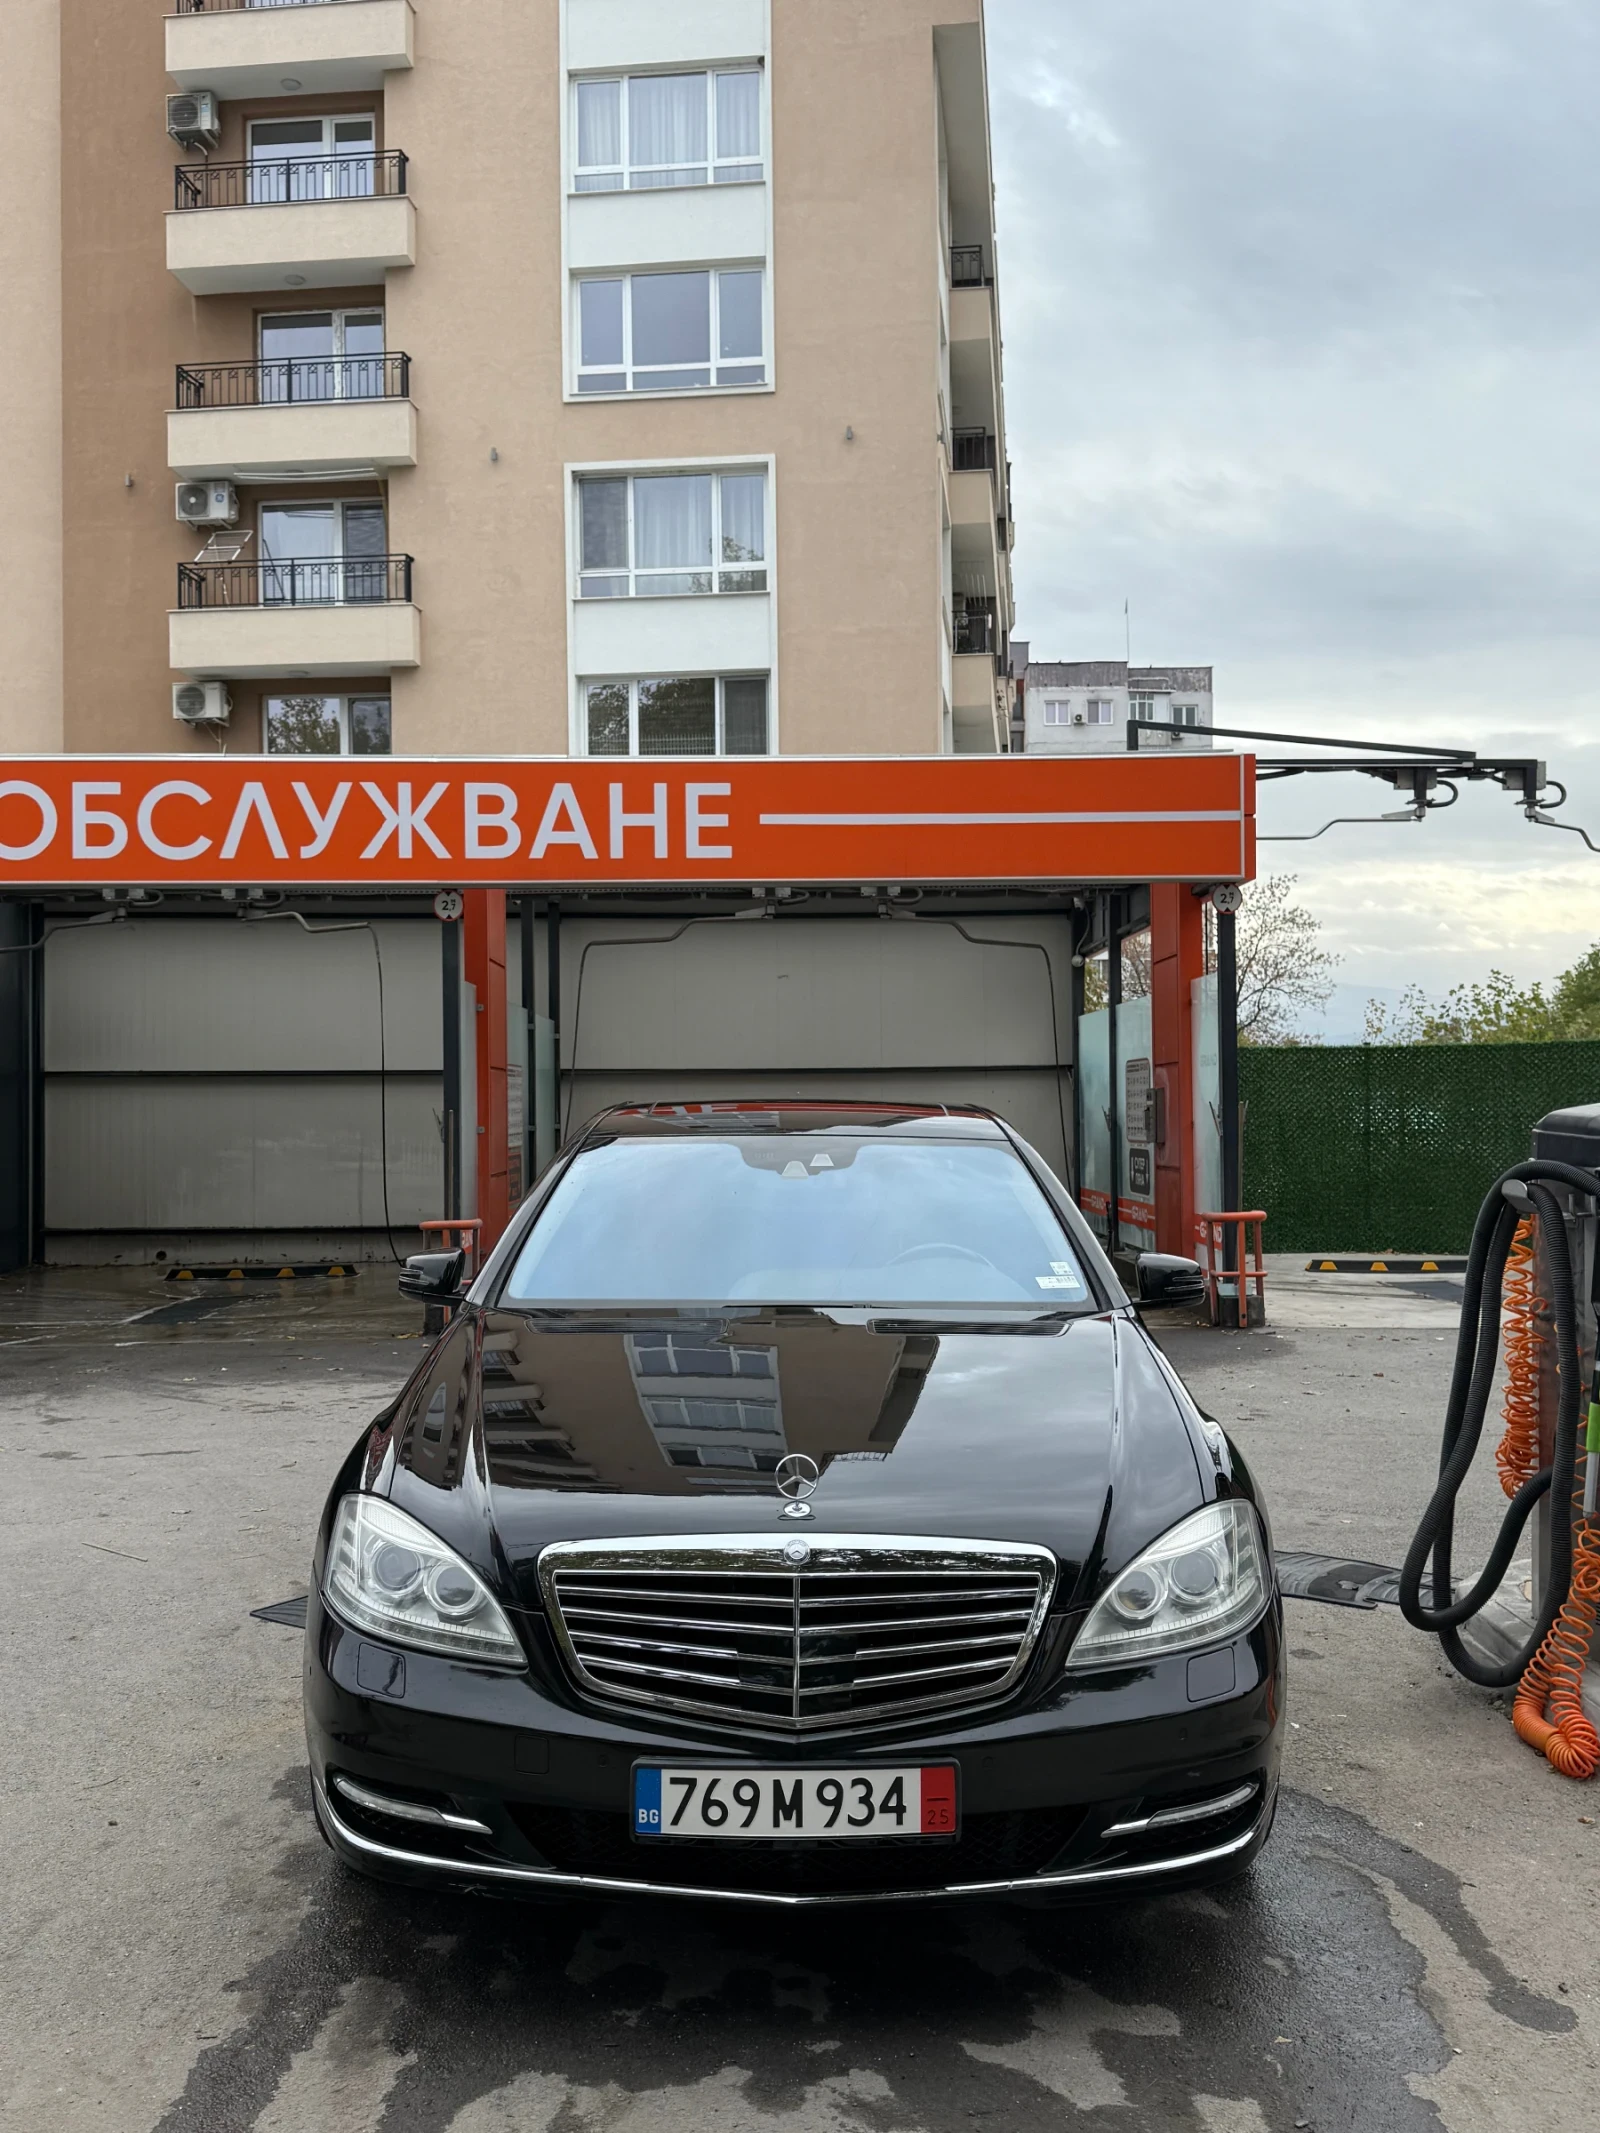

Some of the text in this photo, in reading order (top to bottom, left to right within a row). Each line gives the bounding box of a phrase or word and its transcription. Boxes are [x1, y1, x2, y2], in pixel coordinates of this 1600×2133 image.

[0, 780, 733, 860] ОБСЛУЖВАНЕ
[638, 1808, 659, 1824] BG
[926, 1809, 949, 1826] 25
